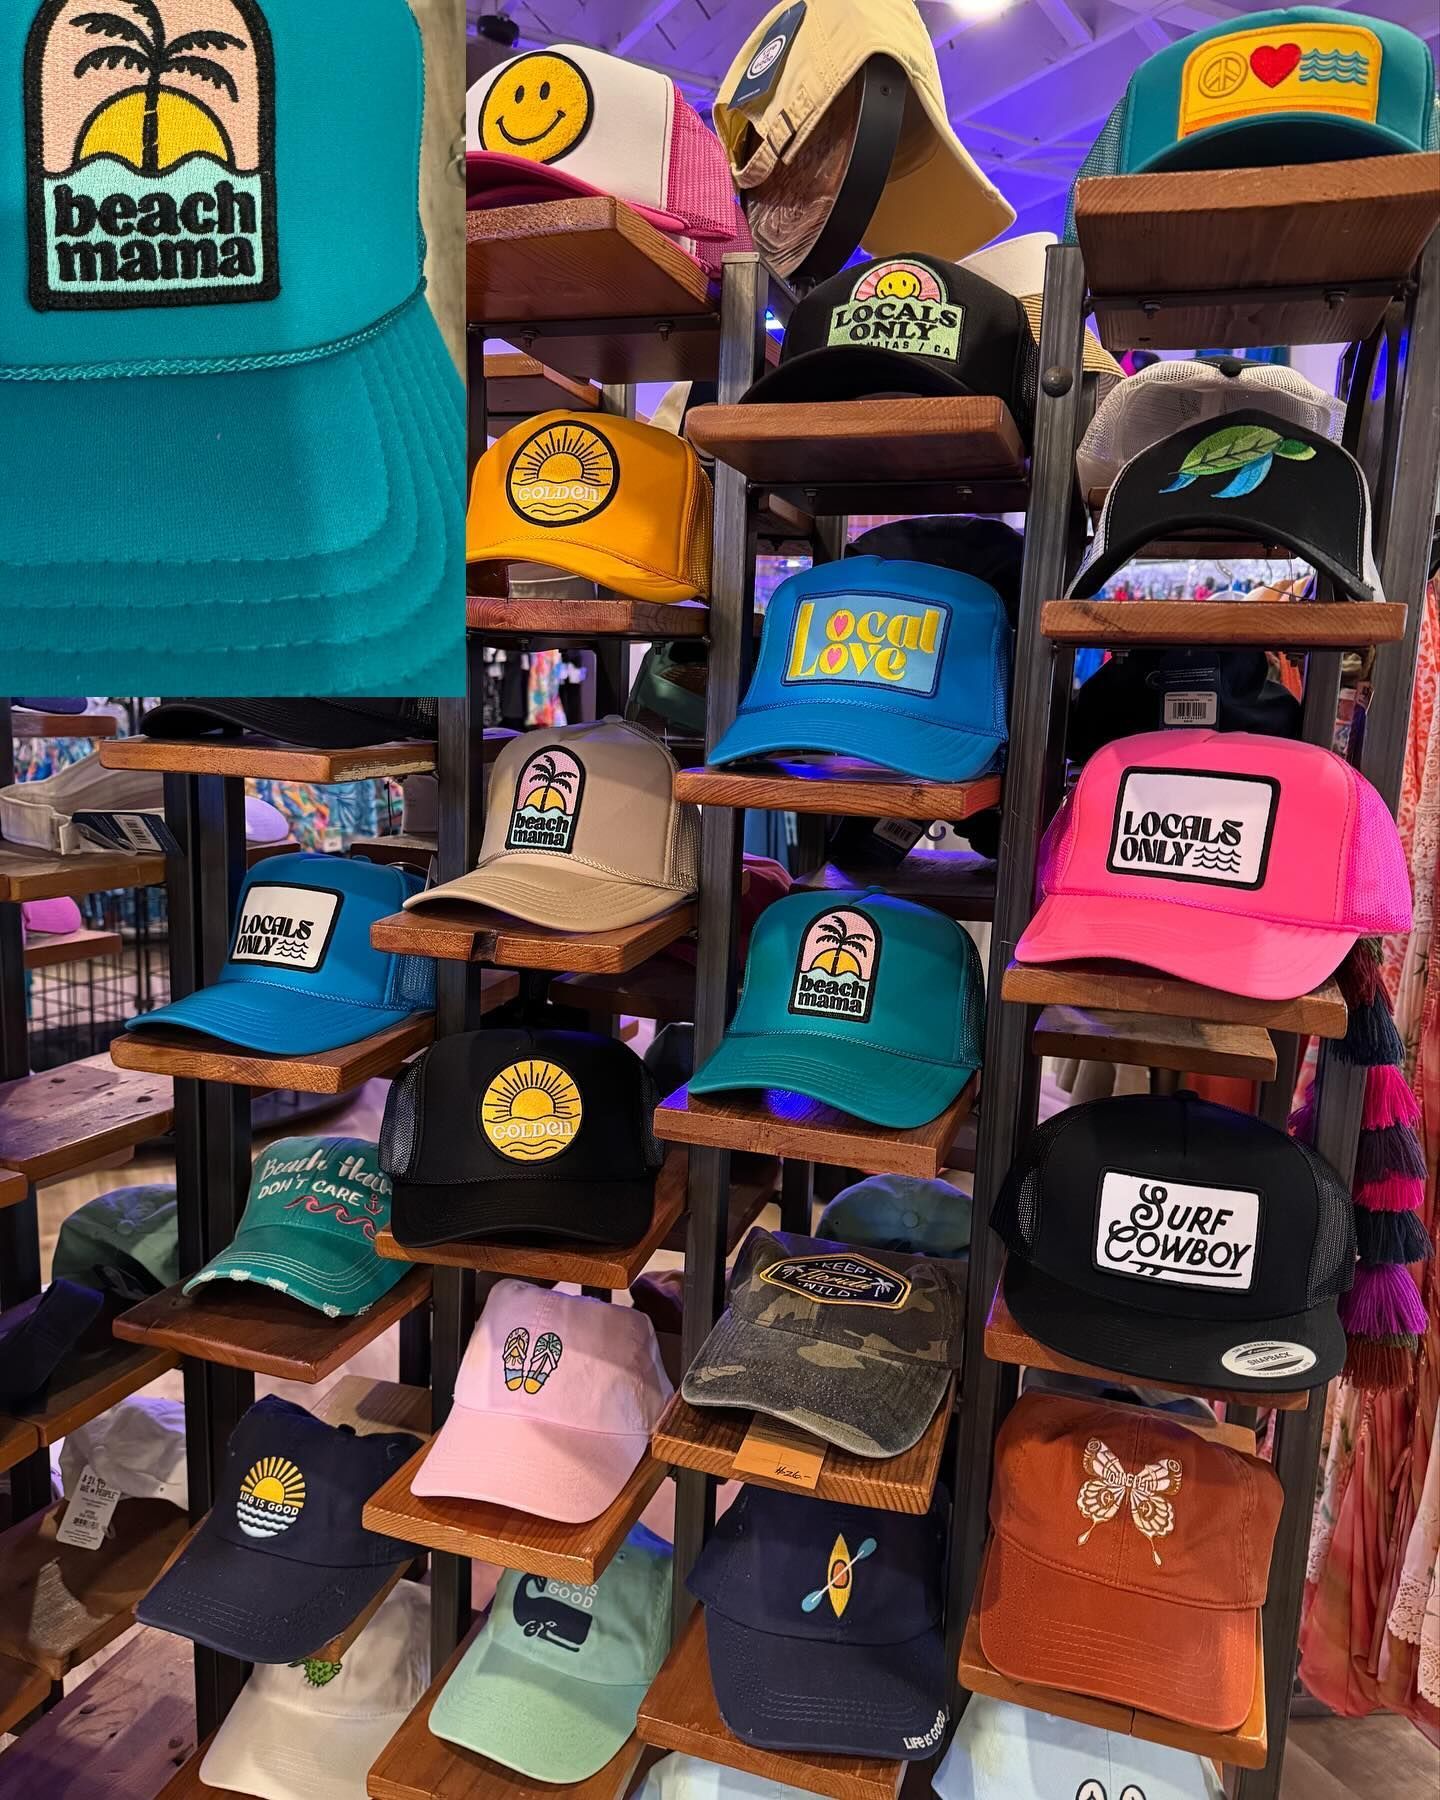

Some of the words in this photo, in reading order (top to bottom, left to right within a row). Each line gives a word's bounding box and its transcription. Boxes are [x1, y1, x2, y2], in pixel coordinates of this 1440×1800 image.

[53, 180, 257, 237] beach
[55, 237, 256, 282] mama
[834, 303, 958, 329] LOCALS
[849, 321, 938, 341] ONLY
[934, 345, 951, 356] CA
[515, 812, 570, 834] beach
[1123, 811, 1244, 846] LOCALS
[513, 829, 565, 847] mama
[1120, 837, 1194, 866] ONLY
[241, 914, 315, 940] LOCALS
[236, 935, 279, 955] ONLY
[799, 975, 867, 1000] beach
[797, 992, 863, 1014] mama
[259, 1149, 328, 1183] Beach
[257, 1174, 310, 1199] DON'T
[311, 1180, 364, 1207] CARE
[1130, 1183, 1234, 1236] SURF
[1104, 1220, 1252, 1270] COWBOY
[821, 1261, 867, 1275] KEEP
[802, 1281, 851, 1298] WILD
[1246, 1351, 1291, 1366] SNAPBACK
[255, 1498, 265, 1508] IS
[267, 1502, 300, 1517] GOOD
[548, 1582, 594, 1609] GOOD
[584, 1584, 600, 1598] IS
[923, 1733, 933, 1747] IS
[930, 1709, 946, 1741] GOOD
